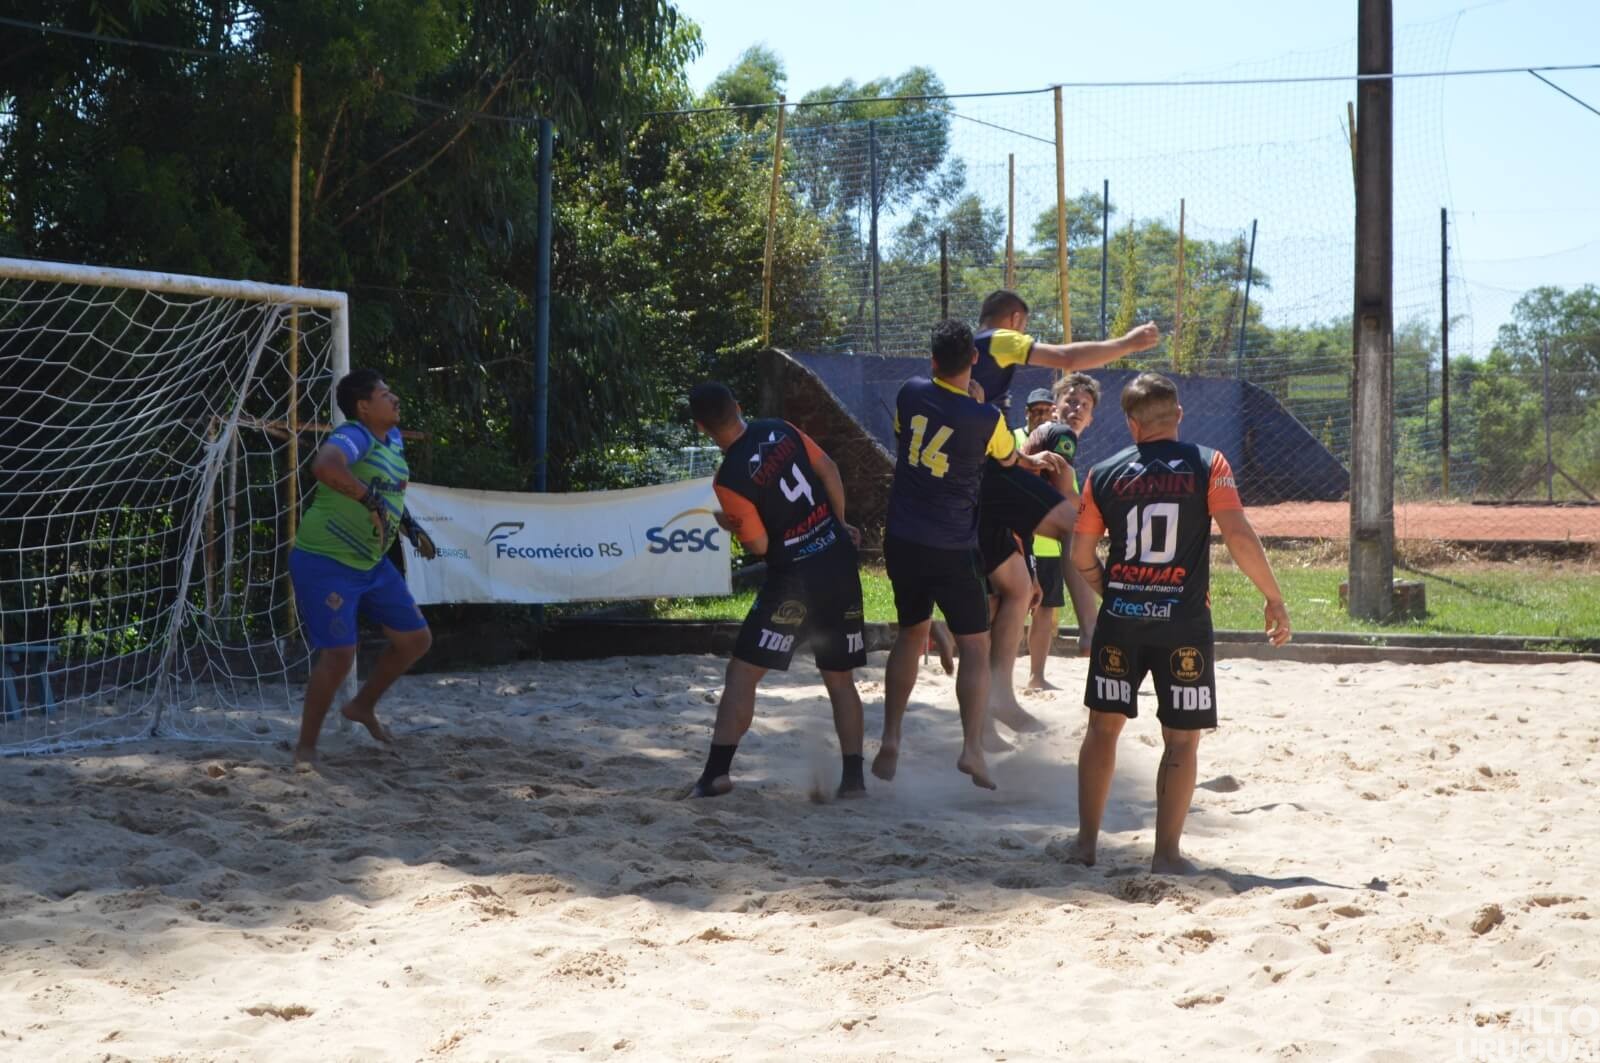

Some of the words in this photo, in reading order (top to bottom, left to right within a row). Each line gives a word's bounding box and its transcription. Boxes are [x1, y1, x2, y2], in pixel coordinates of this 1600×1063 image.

[908, 414, 955, 479] 14
[779, 462, 816, 507] 4
[645, 527, 720, 555] Sesc
[1124, 502, 1180, 564] 10
[496, 542, 594, 559] Fecomércio
[598, 542, 623, 557] RS
[1112, 598, 1171, 618] FreeStal
[758, 628, 795, 652] TDB
[1094, 675, 1132, 704] TDB
[1170, 685, 1212, 711] TDB
